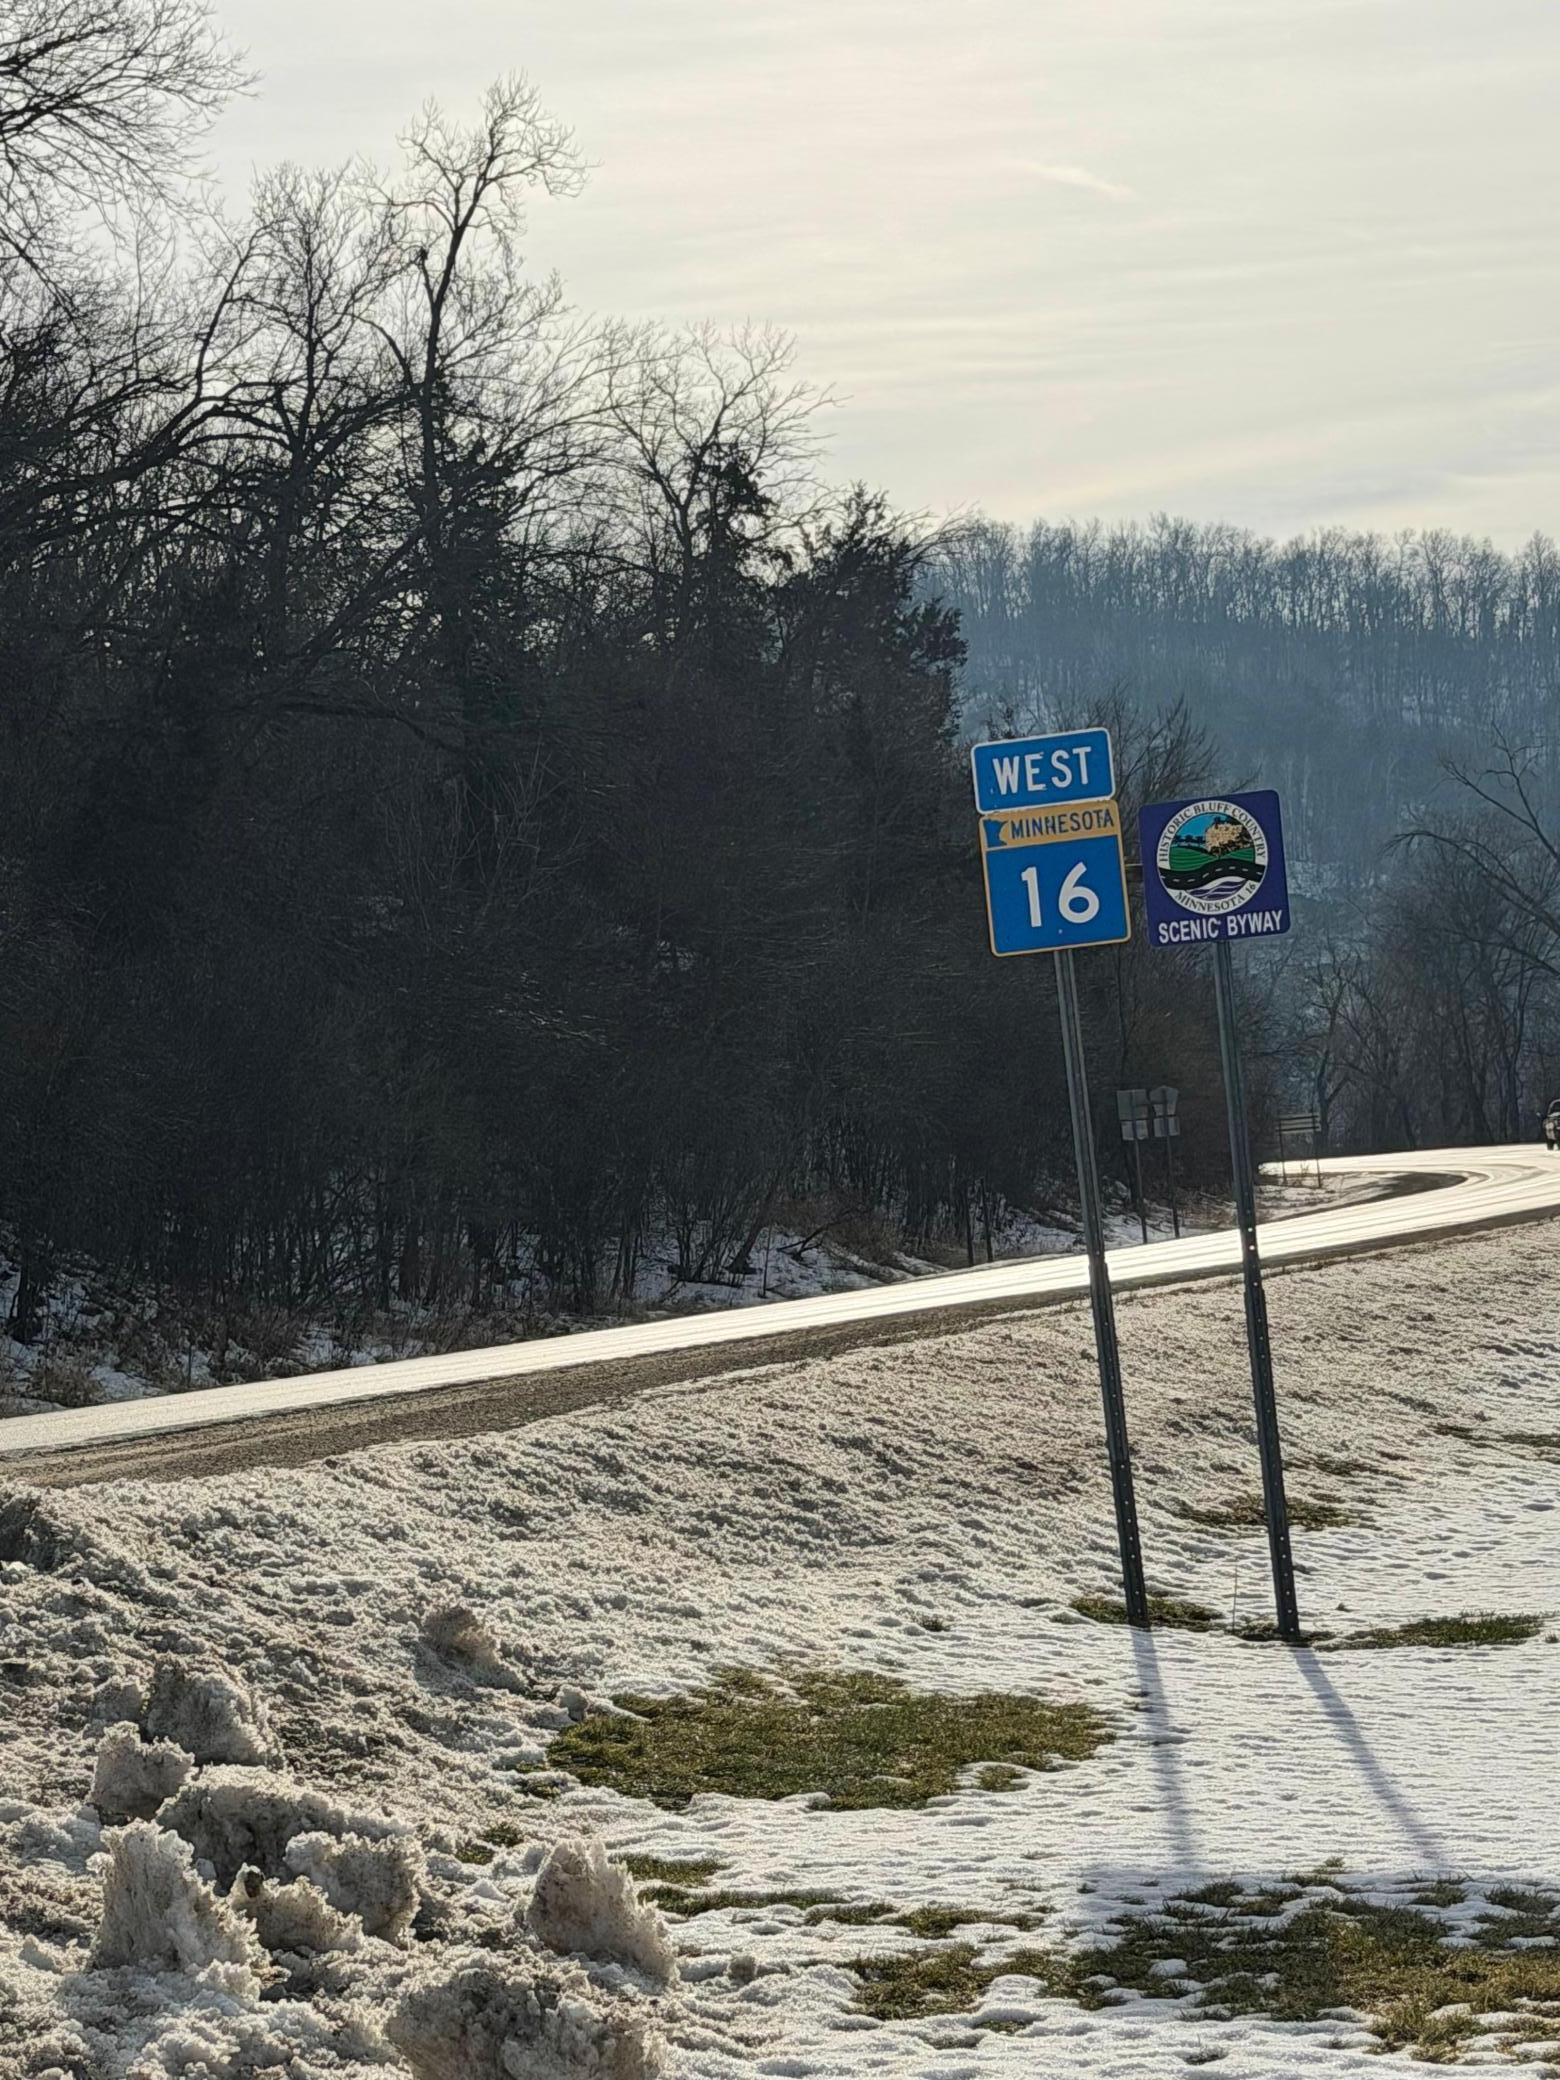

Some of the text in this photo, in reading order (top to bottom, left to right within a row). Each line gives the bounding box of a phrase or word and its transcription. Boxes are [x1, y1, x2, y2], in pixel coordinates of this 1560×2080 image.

[992, 746, 1092, 795] WEST
[1010, 808, 1115, 840] MINNESOTA
[1158, 802, 1267, 863] HISTORIC BLUFF COUNTRY
[1020, 861, 1100, 928] 16
[1174, 883, 1257, 913] MINNESOTA 16
[1158, 909, 1283, 944] SCENIC BYWAY
